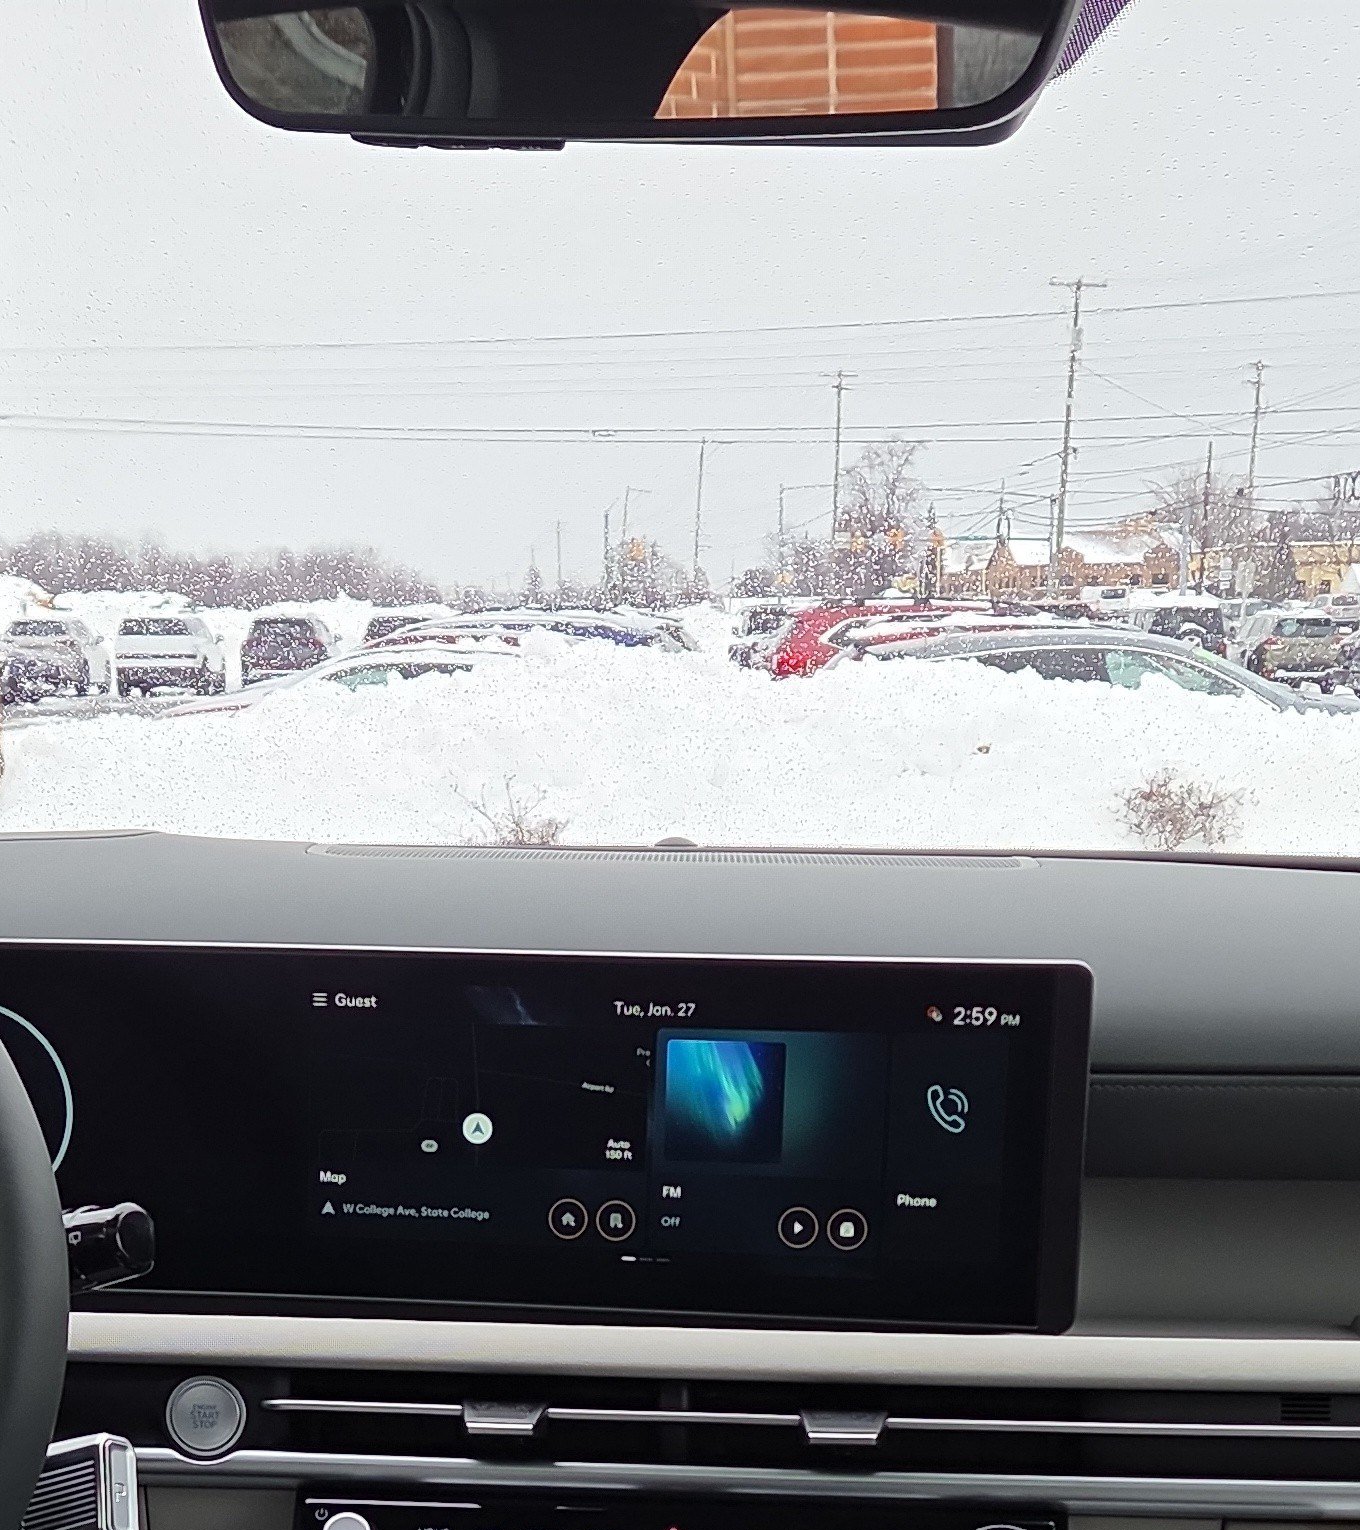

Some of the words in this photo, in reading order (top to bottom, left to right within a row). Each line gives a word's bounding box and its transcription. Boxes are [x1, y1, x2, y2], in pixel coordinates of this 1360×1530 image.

[334, 993, 377, 1009] Guest
[613, 1000, 644, 1017] Tue,
[647, 1002, 674, 1017] Jan.
[677, 1003, 696, 1017] 27
[952, 1007, 998, 1026] 2:59
[1000, 1014, 1020, 1027] PM
[607, 1139, 631, 1150] Auto
[605, 1149, 623, 1161] 150
[624, 1149, 632, 1161] ft
[319, 1171, 347, 1185] Map
[662, 1186, 682, 1200] FM
[897, 1193, 938, 1208] Phone
[342, 1203, 355, 1214] W
[355, 1204, 394, 1218] College
[396, 1205, 419, 1218] Ave,
[421, 1206, 448, 1218] State
[449, 1208, 490, 1221] College
[661, 1215, 681, 1227] Off
[190, 1411, 220, 1420] START
[193, 1420, 217, 1429] STOP
